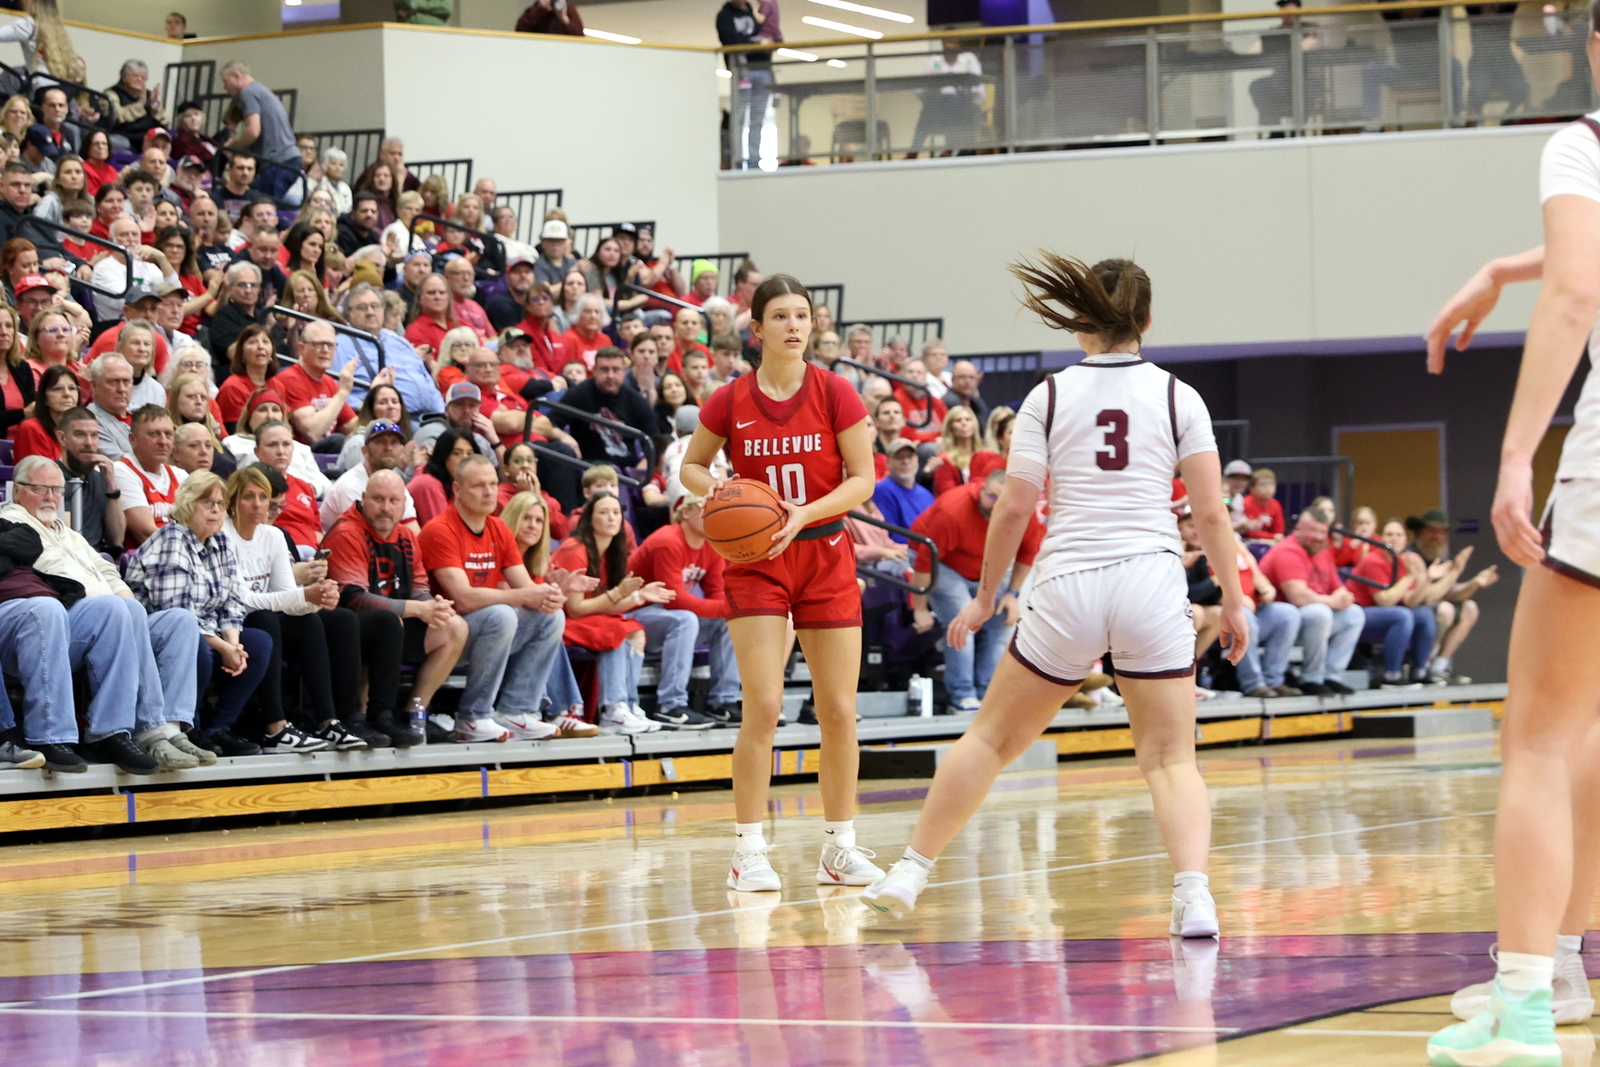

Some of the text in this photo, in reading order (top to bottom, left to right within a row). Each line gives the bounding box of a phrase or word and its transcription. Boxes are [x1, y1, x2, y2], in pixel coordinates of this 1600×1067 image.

[744, 433, 822, 457] BELLEVUE
[1096, 409, 1129, 471] 3
[766, 463, 807, 506] 10
